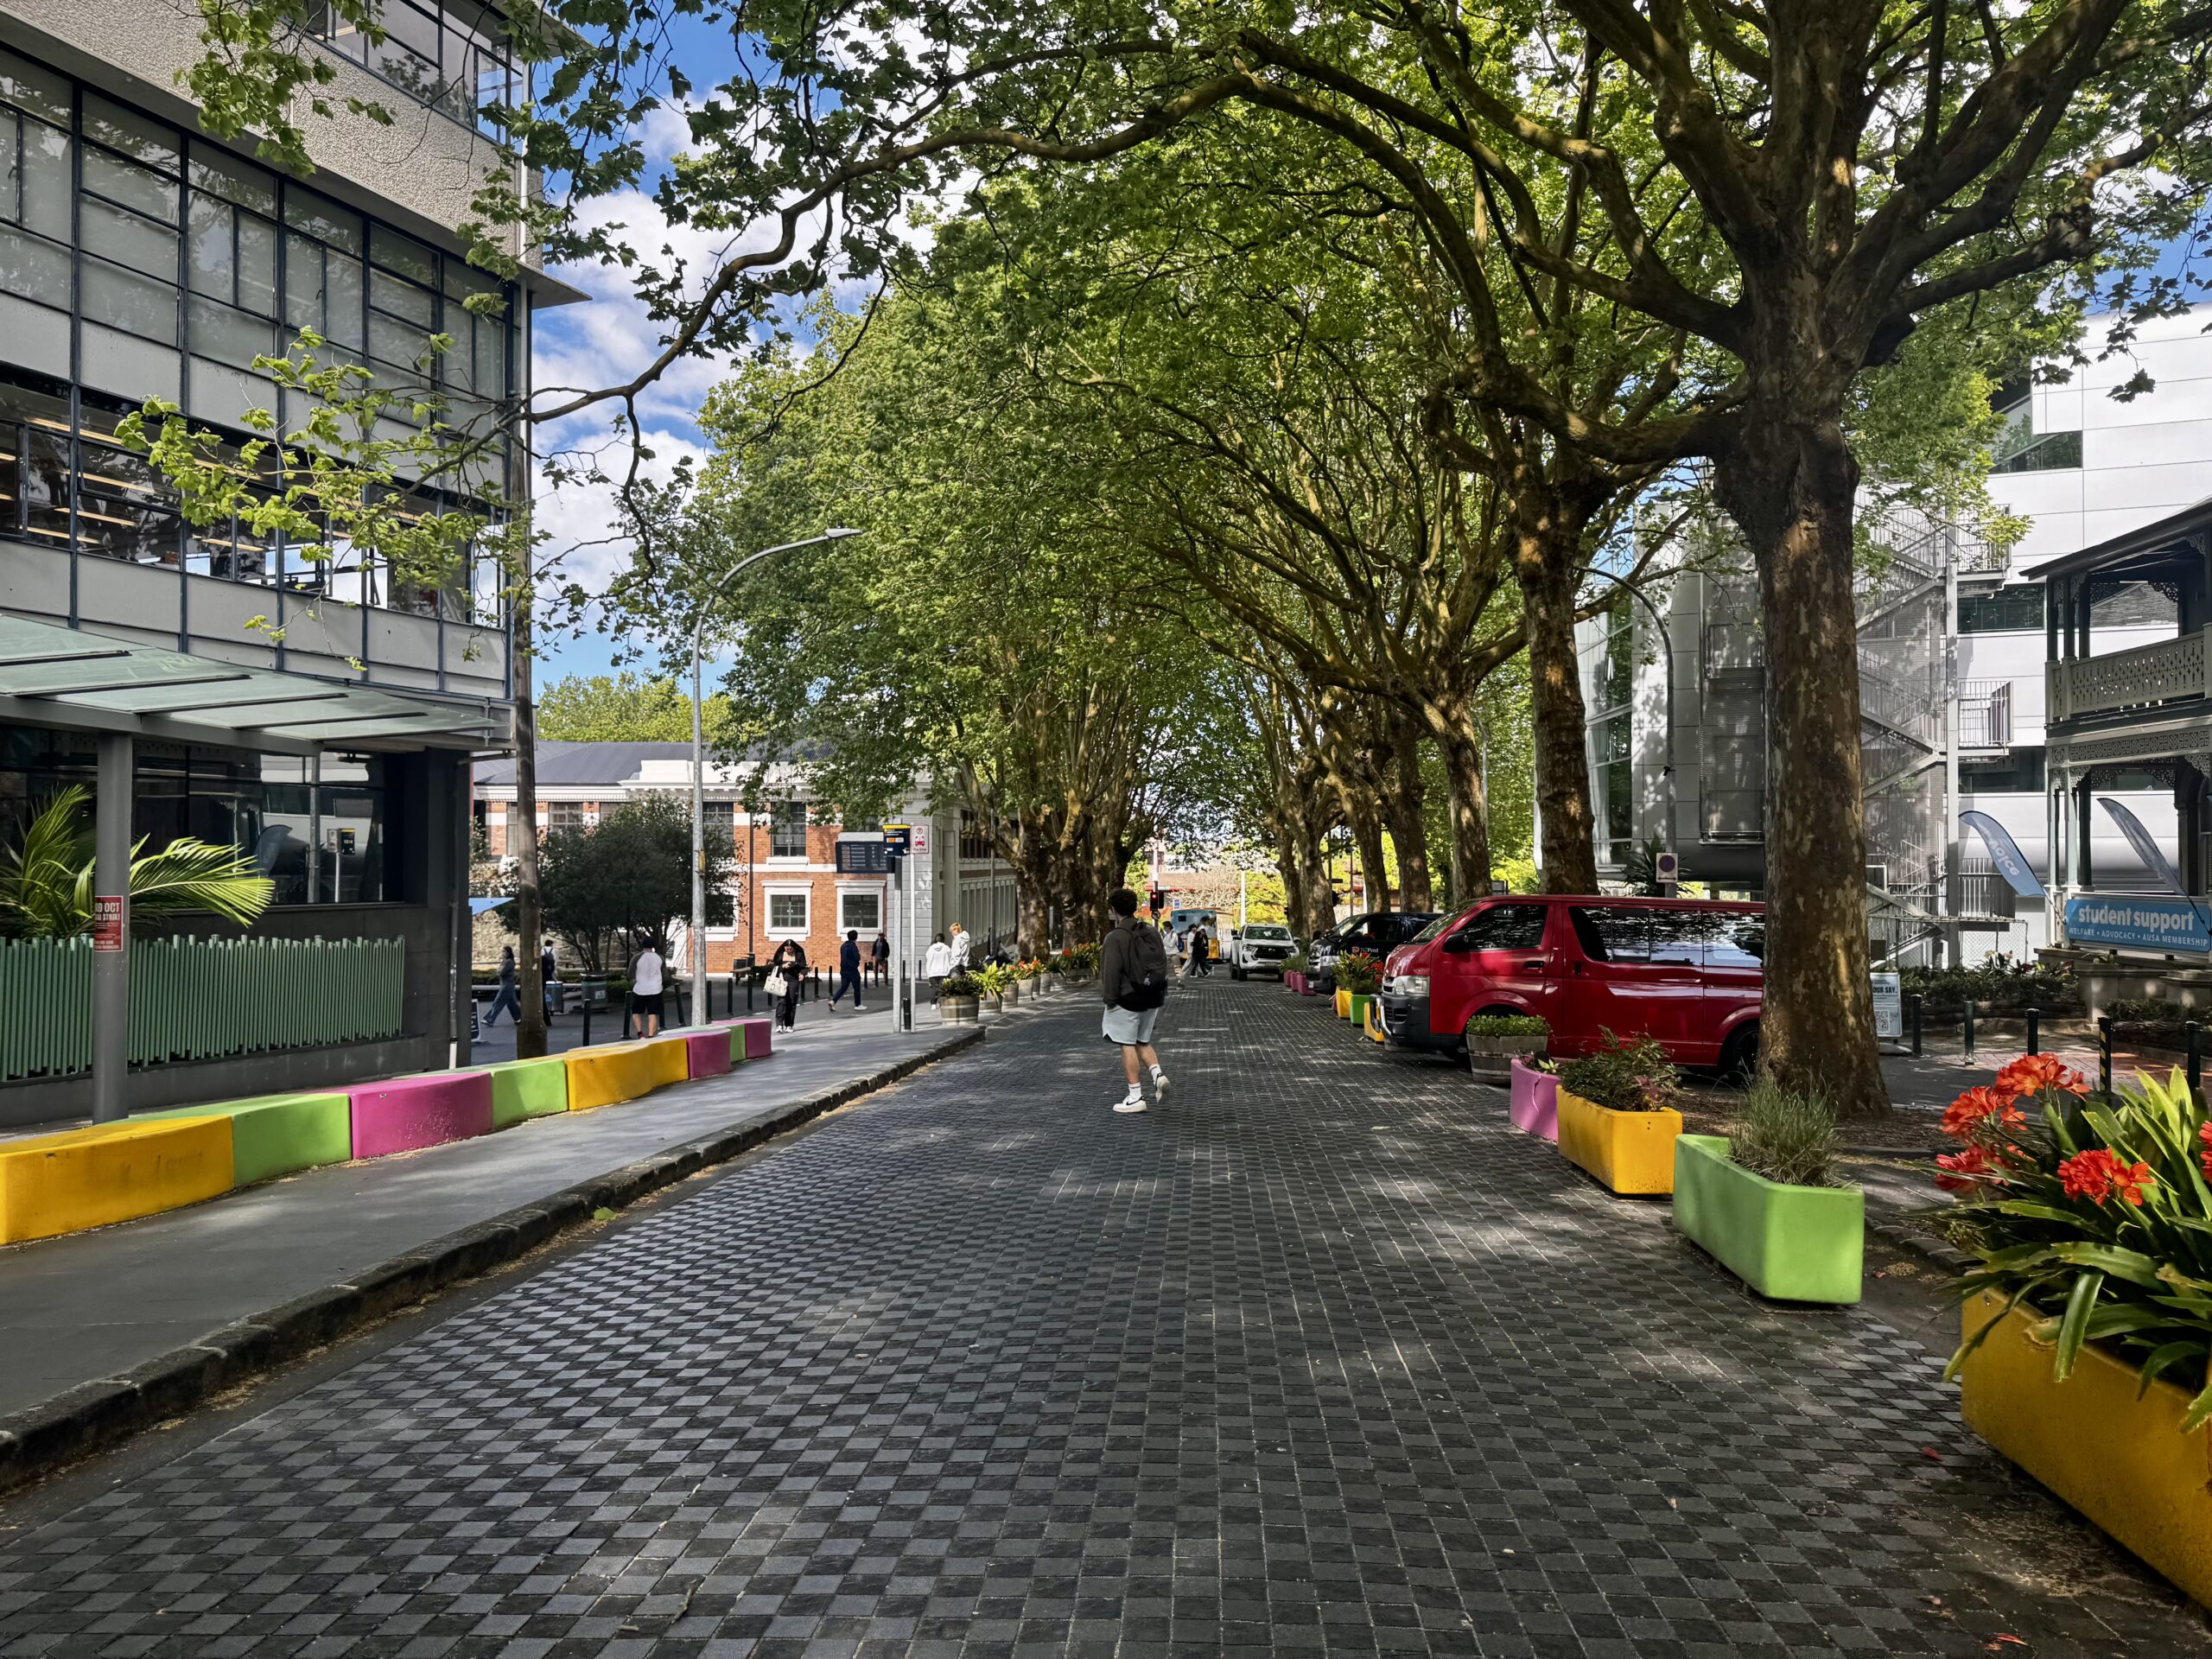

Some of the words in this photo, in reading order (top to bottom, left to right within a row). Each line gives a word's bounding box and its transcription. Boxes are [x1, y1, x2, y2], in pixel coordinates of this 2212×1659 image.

[105, 902, 120, 912] OCT
[2079, 905, 2132, 925] student
[2133, 911, 2194, 933] support
[2069, 927, 2094, 936] WELFARE
[2101, 930, 2135, 939] ADVOCACY
[2162, 935, 2208, 946] MEMBERSHIP
